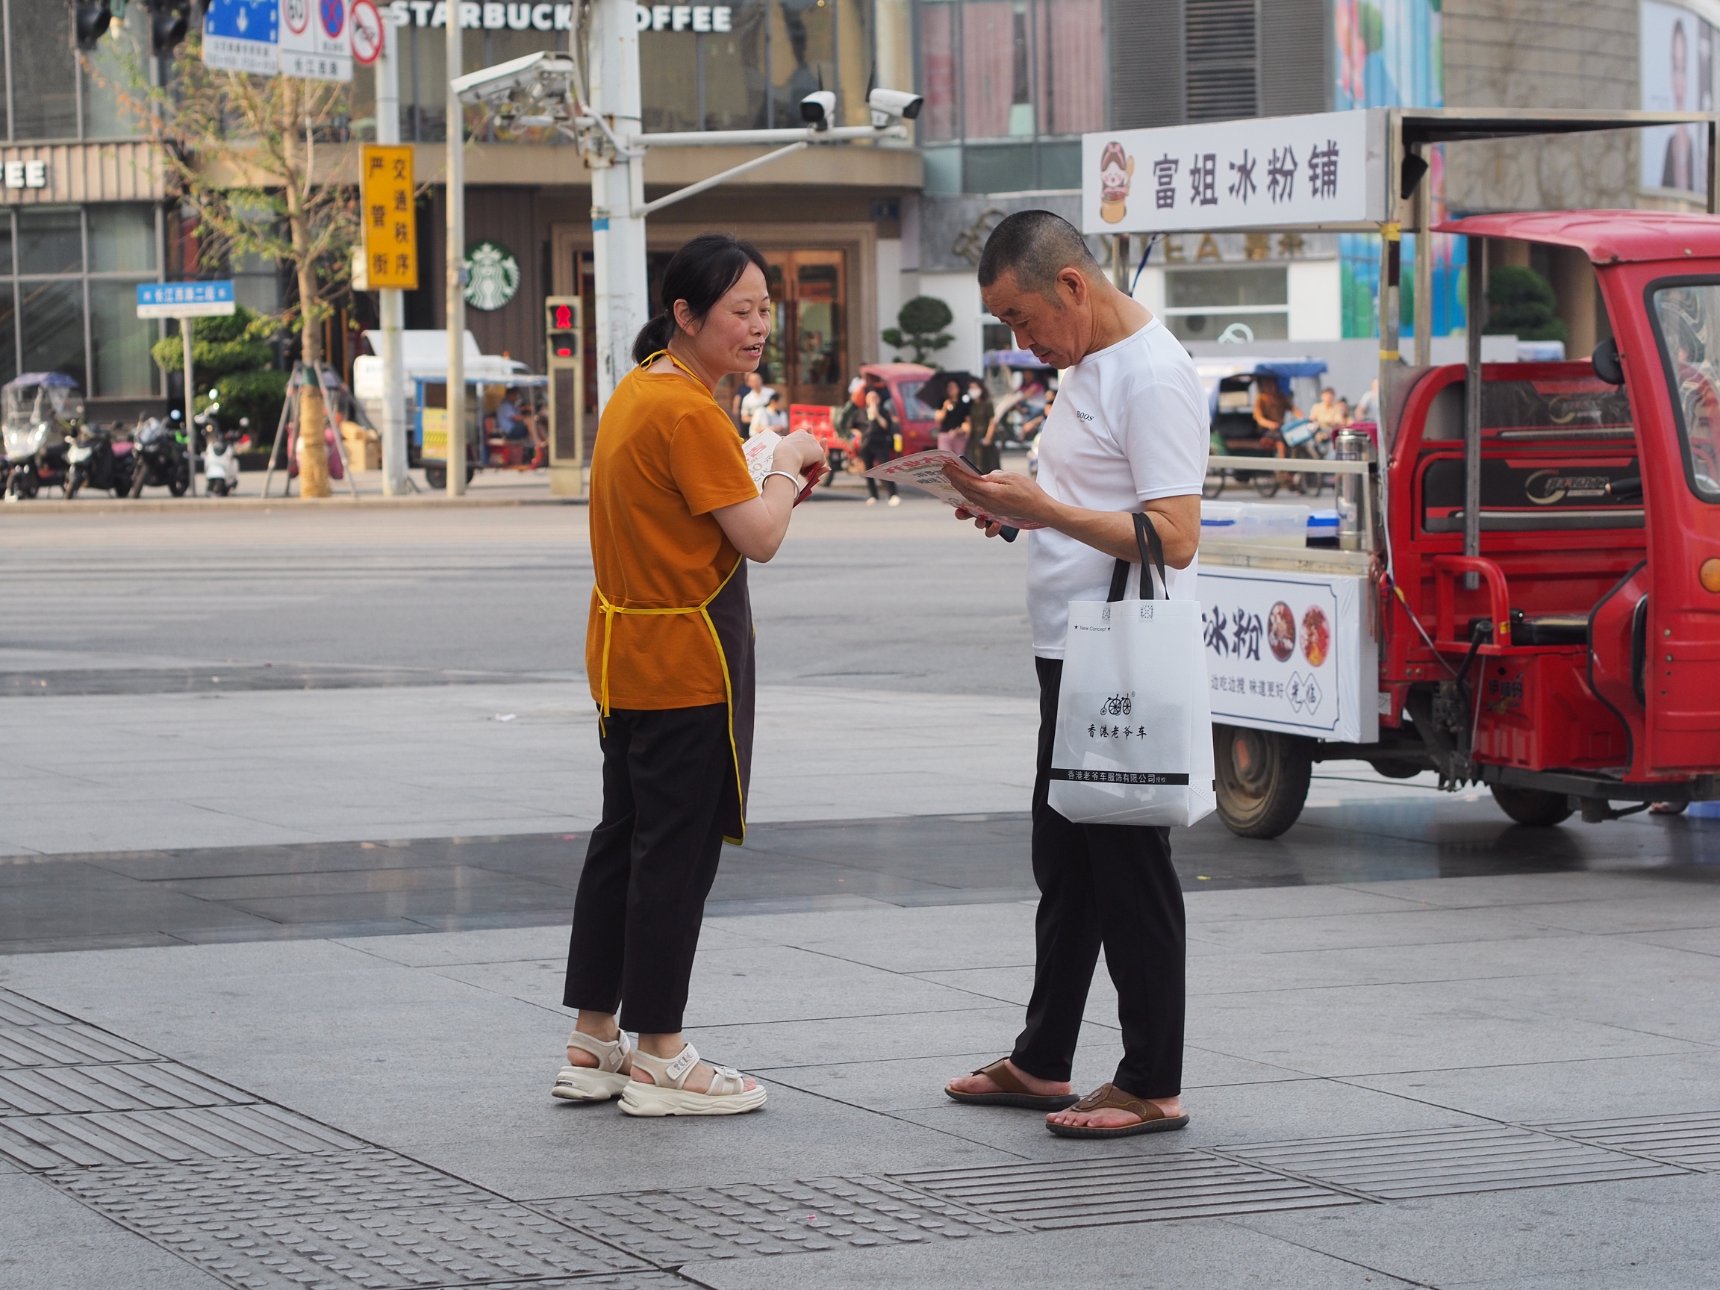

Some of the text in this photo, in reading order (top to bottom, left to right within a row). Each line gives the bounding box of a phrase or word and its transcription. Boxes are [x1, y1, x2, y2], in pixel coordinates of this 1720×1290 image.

[391, 0, 733, 33] STARBUCK OFFEE
[0, 158, 47, 189] EE
[1153, 139, 1341, 209] 富姐冰粉铺
[1201, 604, 1263, 661] 冰粉
[1087, 723, 1148, 741] 香港老爷车
